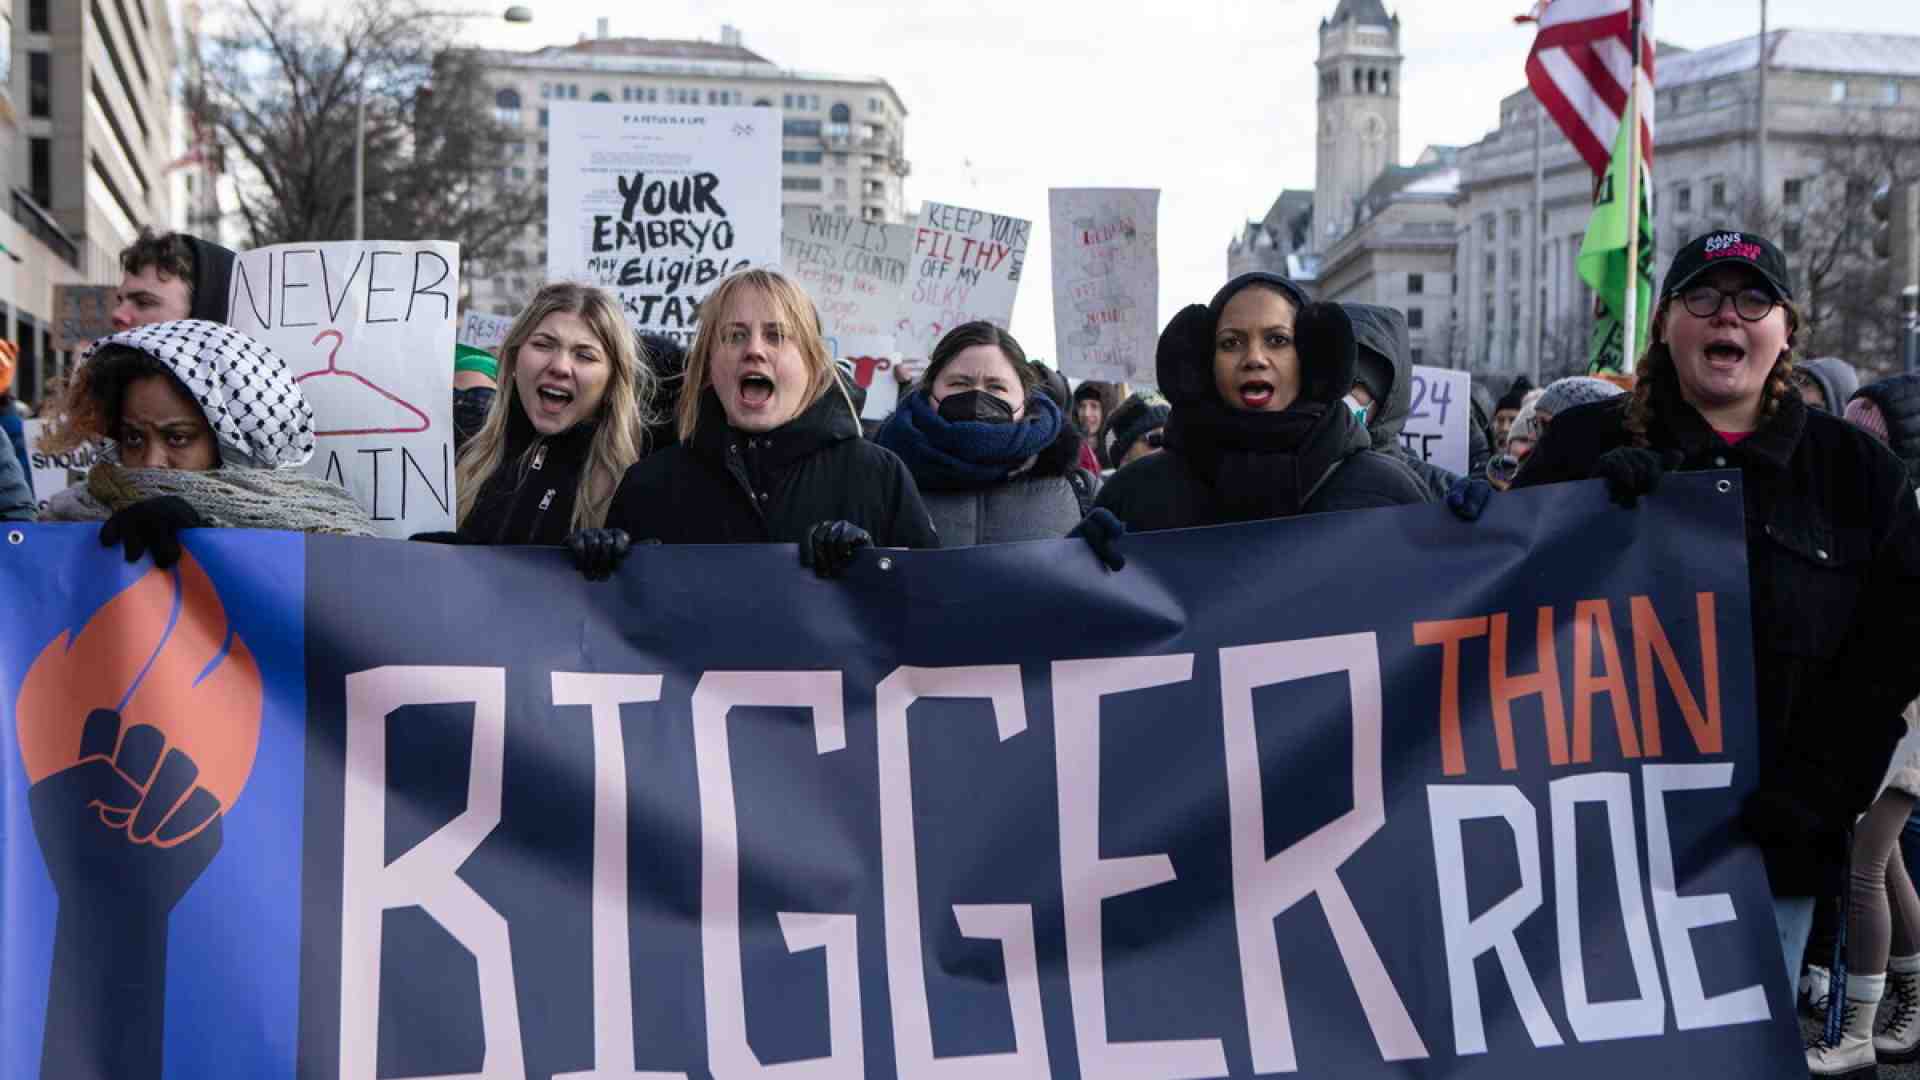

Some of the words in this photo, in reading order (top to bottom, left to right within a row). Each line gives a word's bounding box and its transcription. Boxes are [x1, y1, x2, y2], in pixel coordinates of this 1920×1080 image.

[617, 171, 726, 223] YOUR
[591, 215, 735, 254] EMBRYO
[808, 211, 854, 243] WHY
[850, 222, 888, 253] IS
[928, 203, 984, 234] KEEP
[990, 213, 1026, 246] YOUR
[785, 237, 837, 270] THIS
[842, 246, 905, 287] COUNTRY
[914, 226, 1010, 272] FILTHY
[920, 258, 949, 280] OFF
[955, 265, 981, 287] MY
[230, 249, 450, 329] NEVER
[638, 295, 703, 328] TAX
[1412, 591, 1724, 777] THAN
[339, 631, 1431, 1080] BIGGER
[1426, 761, 1773, 1056] ROE
